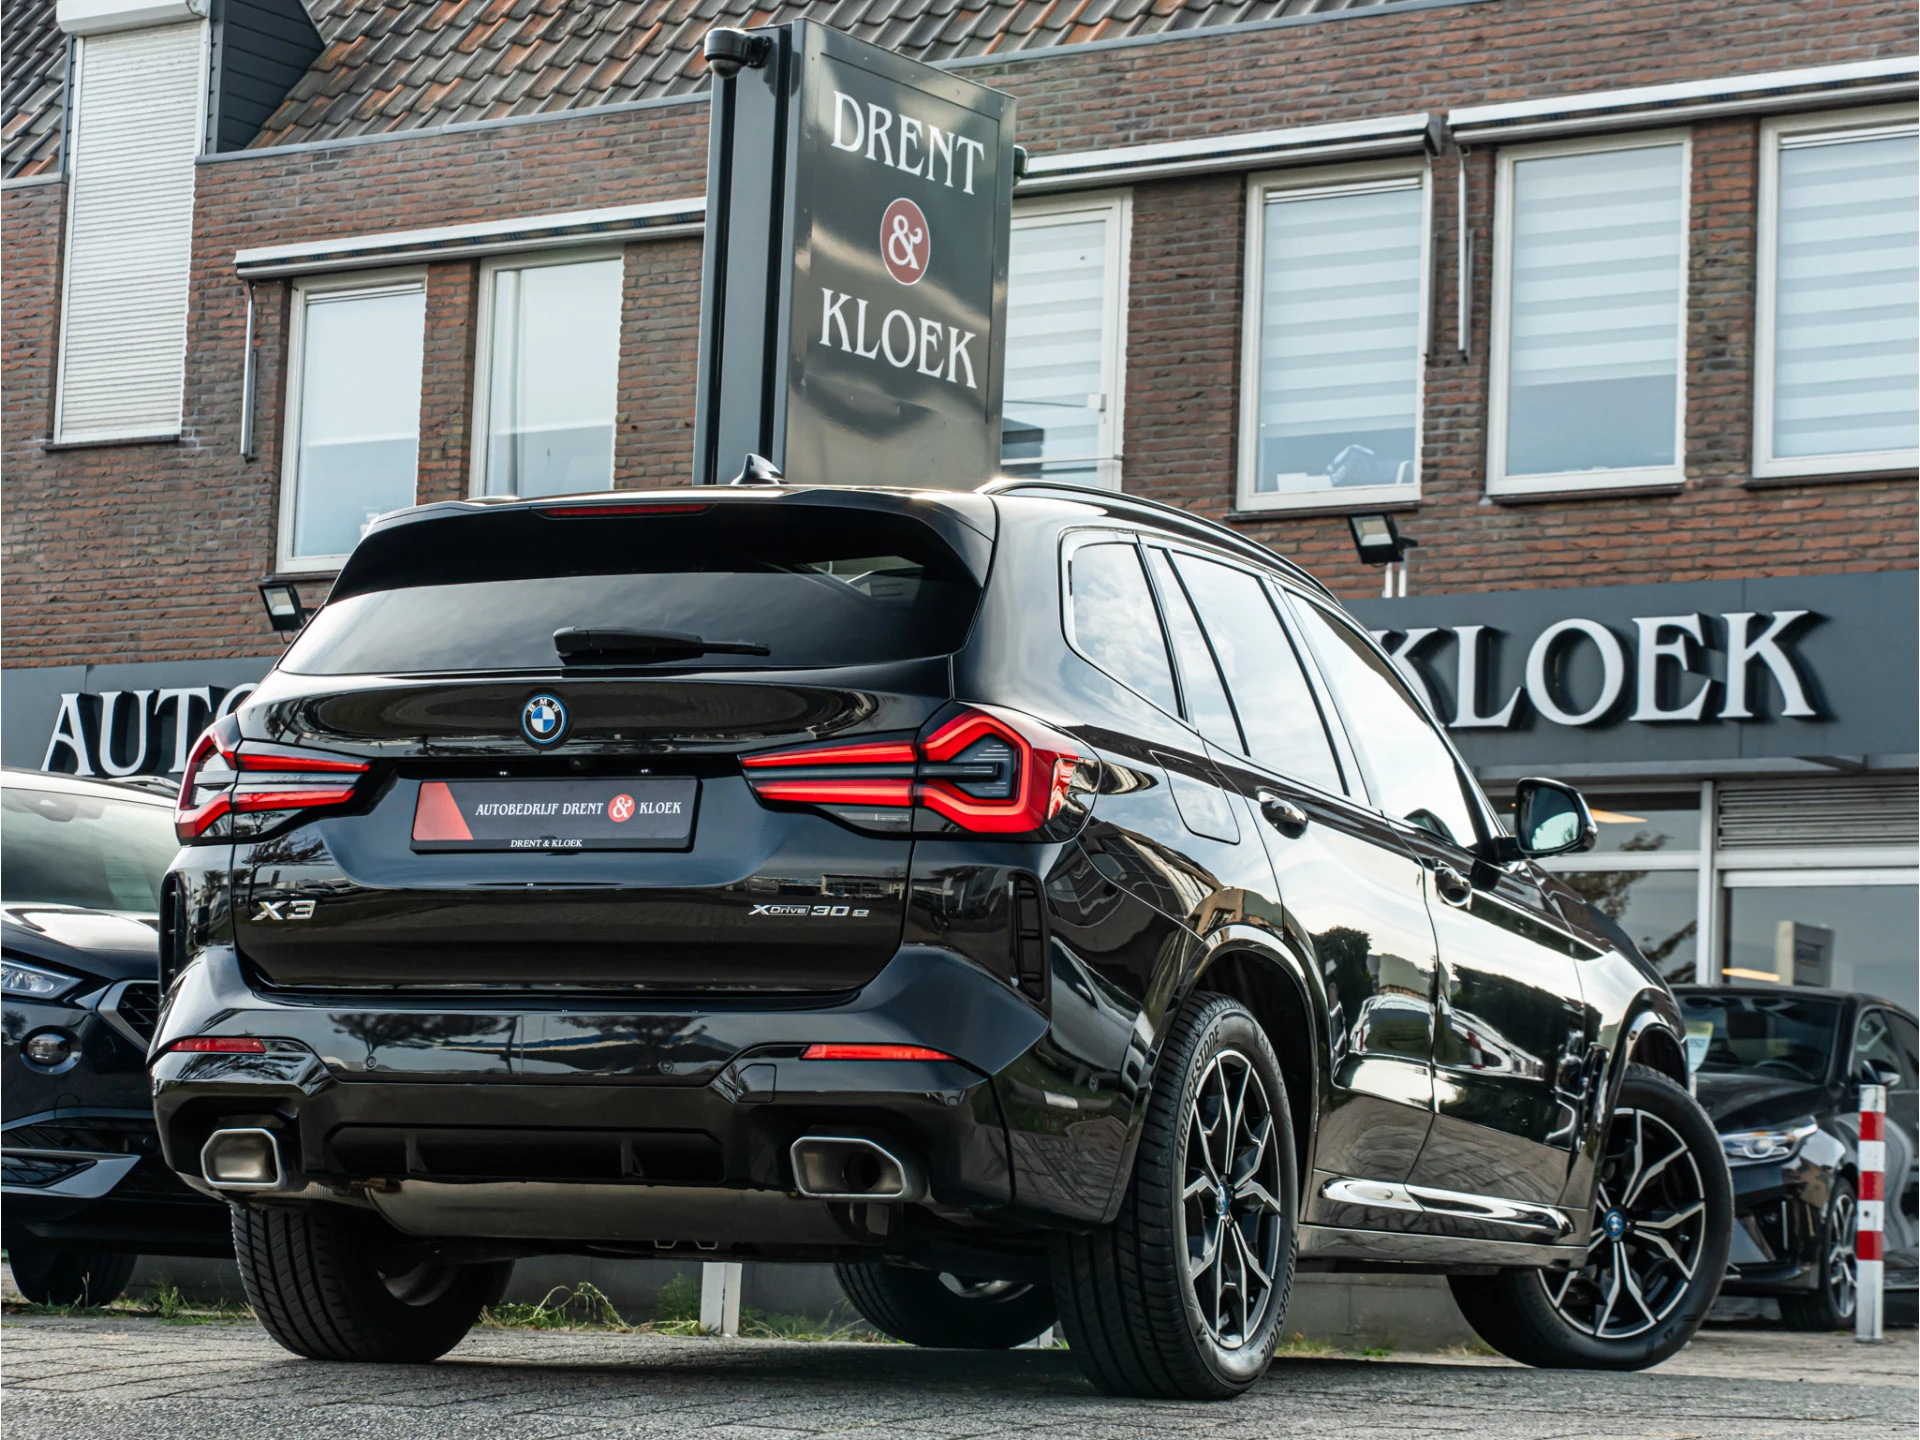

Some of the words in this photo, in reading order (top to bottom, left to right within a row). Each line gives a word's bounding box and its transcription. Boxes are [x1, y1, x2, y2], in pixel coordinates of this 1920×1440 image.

[831, 90, 985, 195] DRENT
[888, 214, 923, 270] &
[819, 287, 977, 389] KLOEK
[41, 683, 259, 776] AUT
[527, 698, 560, 713] BMW
[475, 802, 559, 816] AUTOBEDRIJF
[562, 802, 604, 815] DRENT
[612, 797, 632, 818] &
[639, 801, 682, 814] KLOEK
[510, 839, 542, 848] DRENT
[542, 839, 550, 848] &
[551, 839, 583, 848] KLOEK
[251, 899, 317, 921] X3
[1178, 1024, 1221, 1163] BRIDGESTONE
